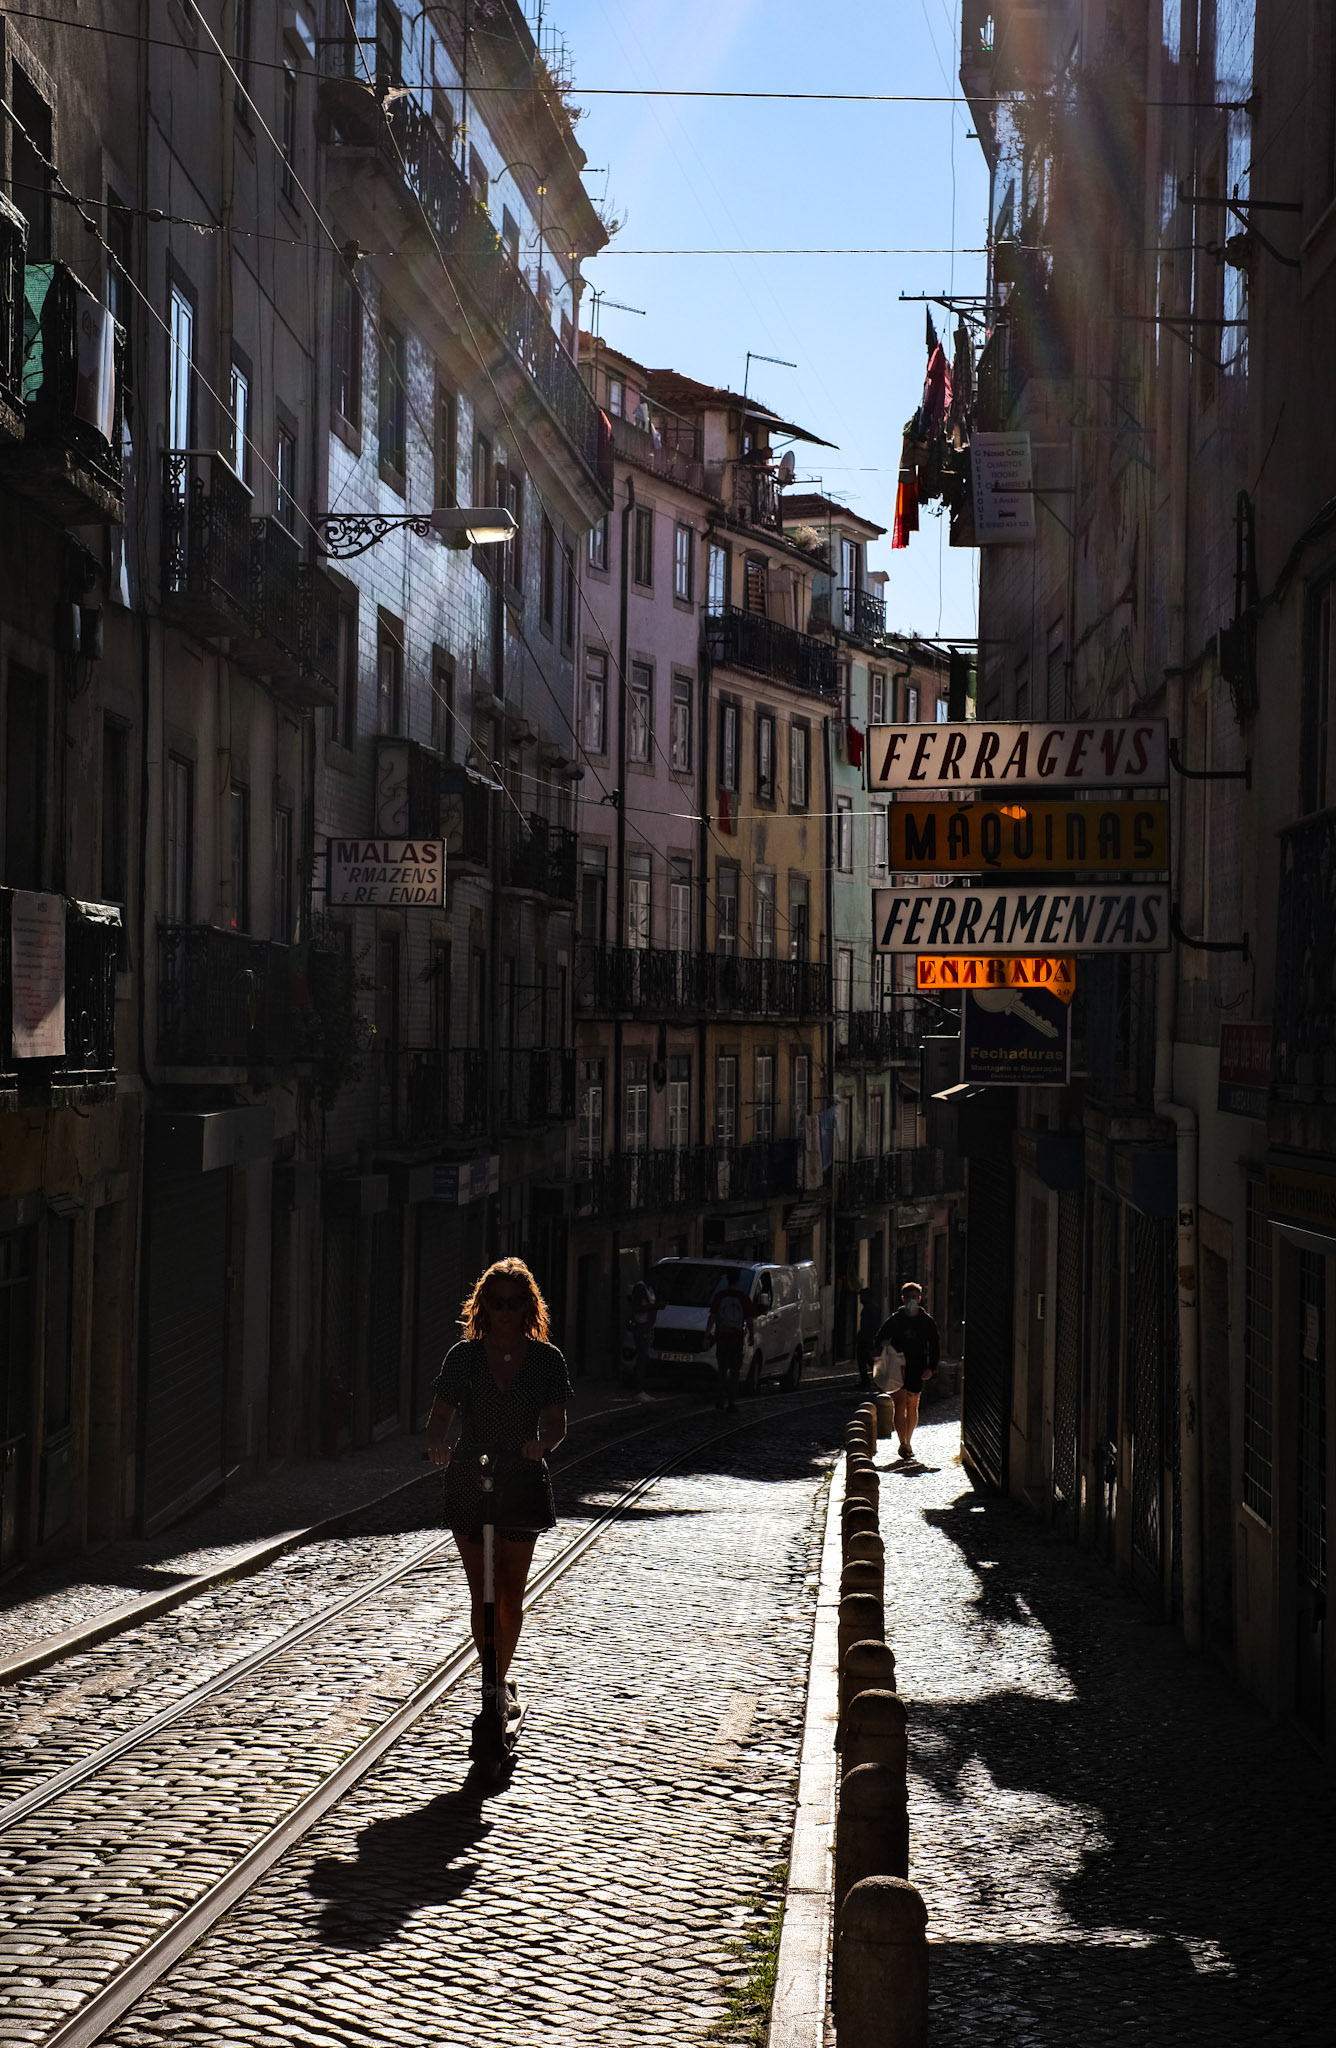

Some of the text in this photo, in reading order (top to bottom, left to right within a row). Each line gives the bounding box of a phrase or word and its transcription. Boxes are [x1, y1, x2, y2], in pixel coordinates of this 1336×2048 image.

[879, 727, 1154, 781] FERRAGENS
[904, 804, 1155, 867] MÁQUINAS
[337, 842, 437, 864] MALAS
[343, 867, 438, 884] RMAZENS
[880, 895, 1162, 945] FERRAMENTAS
[919, 959, 1072, 984] ENTRADA
[969, 1047, 1064, 1060] Fechaduras
